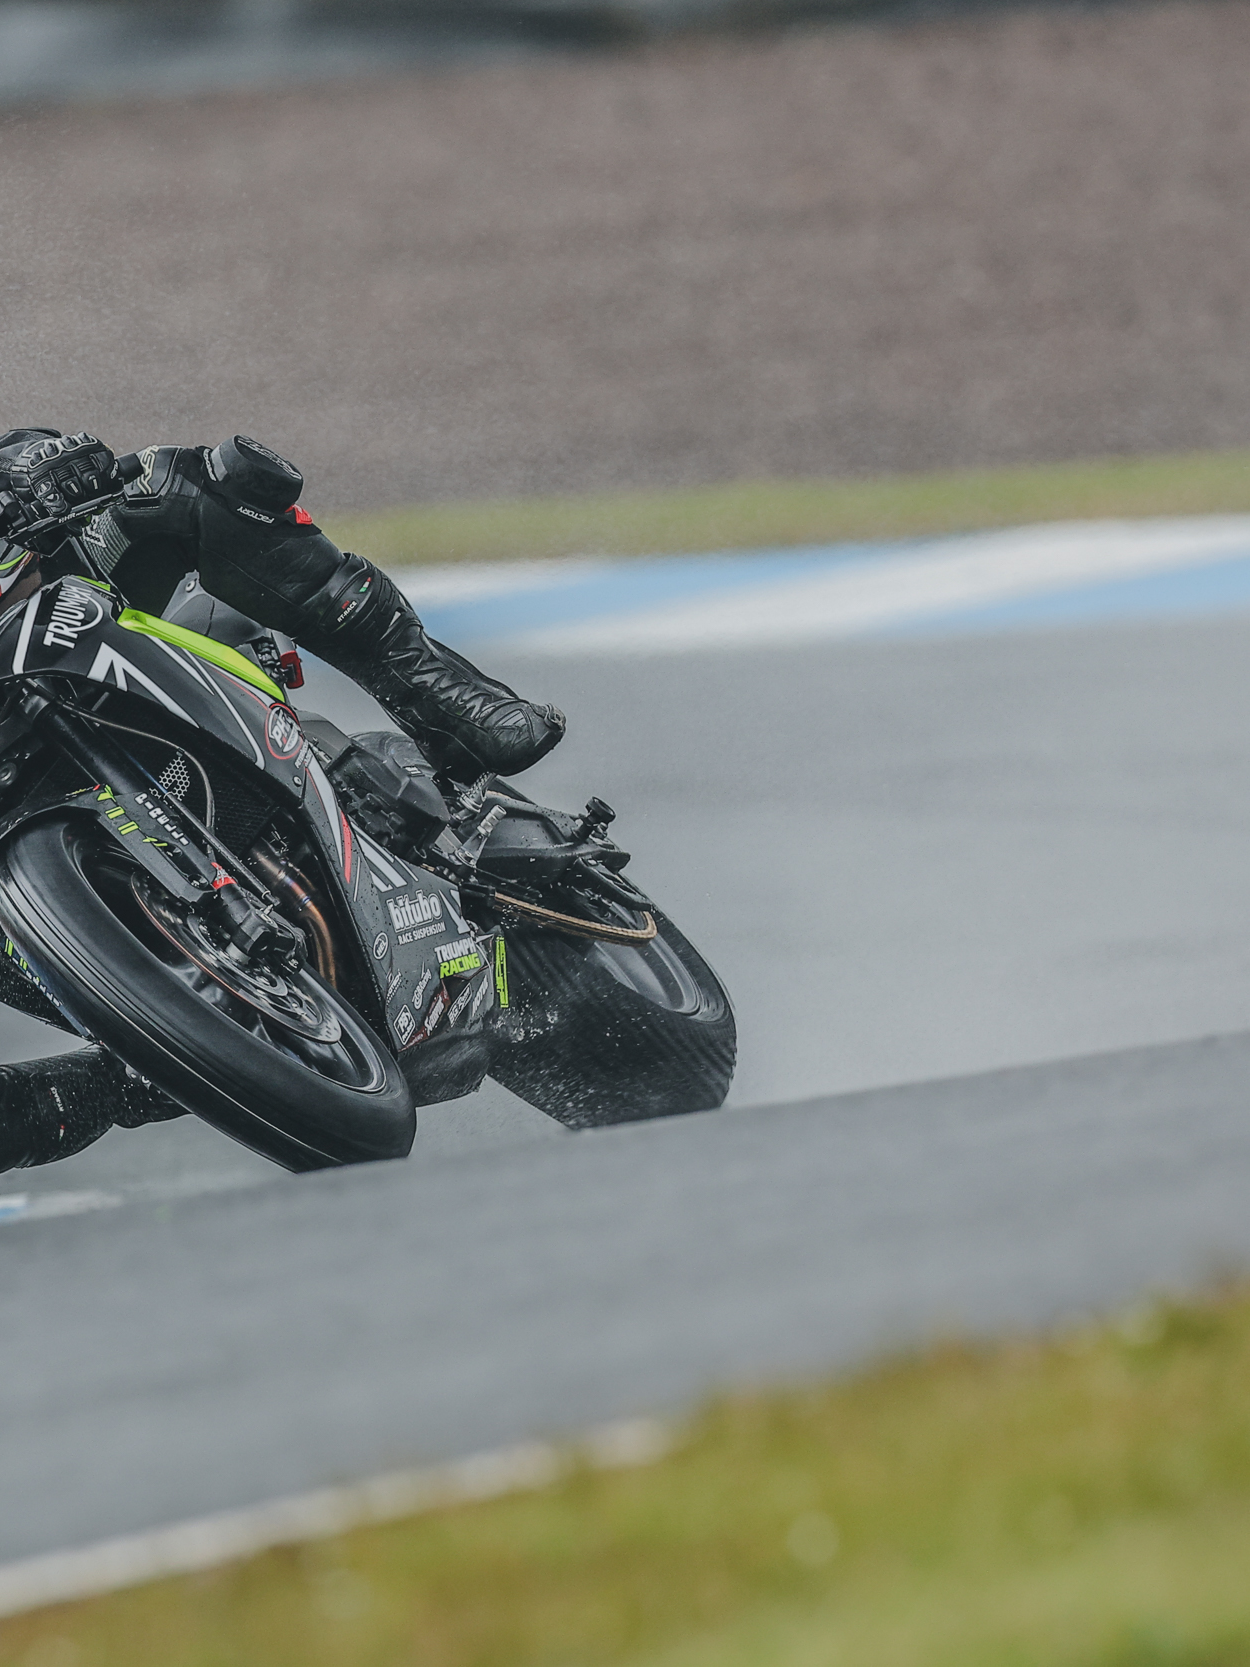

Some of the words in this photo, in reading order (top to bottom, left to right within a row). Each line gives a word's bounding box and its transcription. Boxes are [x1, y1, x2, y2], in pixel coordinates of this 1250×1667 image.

[43, 583, 92, 650] TRIUMPH
[337, 600, 358, 623] RT-RACE
[135, 793, 189, 846] PIRELLI
[387, 890, 443, 932] bitubo
[397, 931, 414, 945] RACE
[412, 921, 447, 940] SUSPENSION
[434, 936, 478, 963] TRIUMPH
[439, 952, 483, 979] RACING
